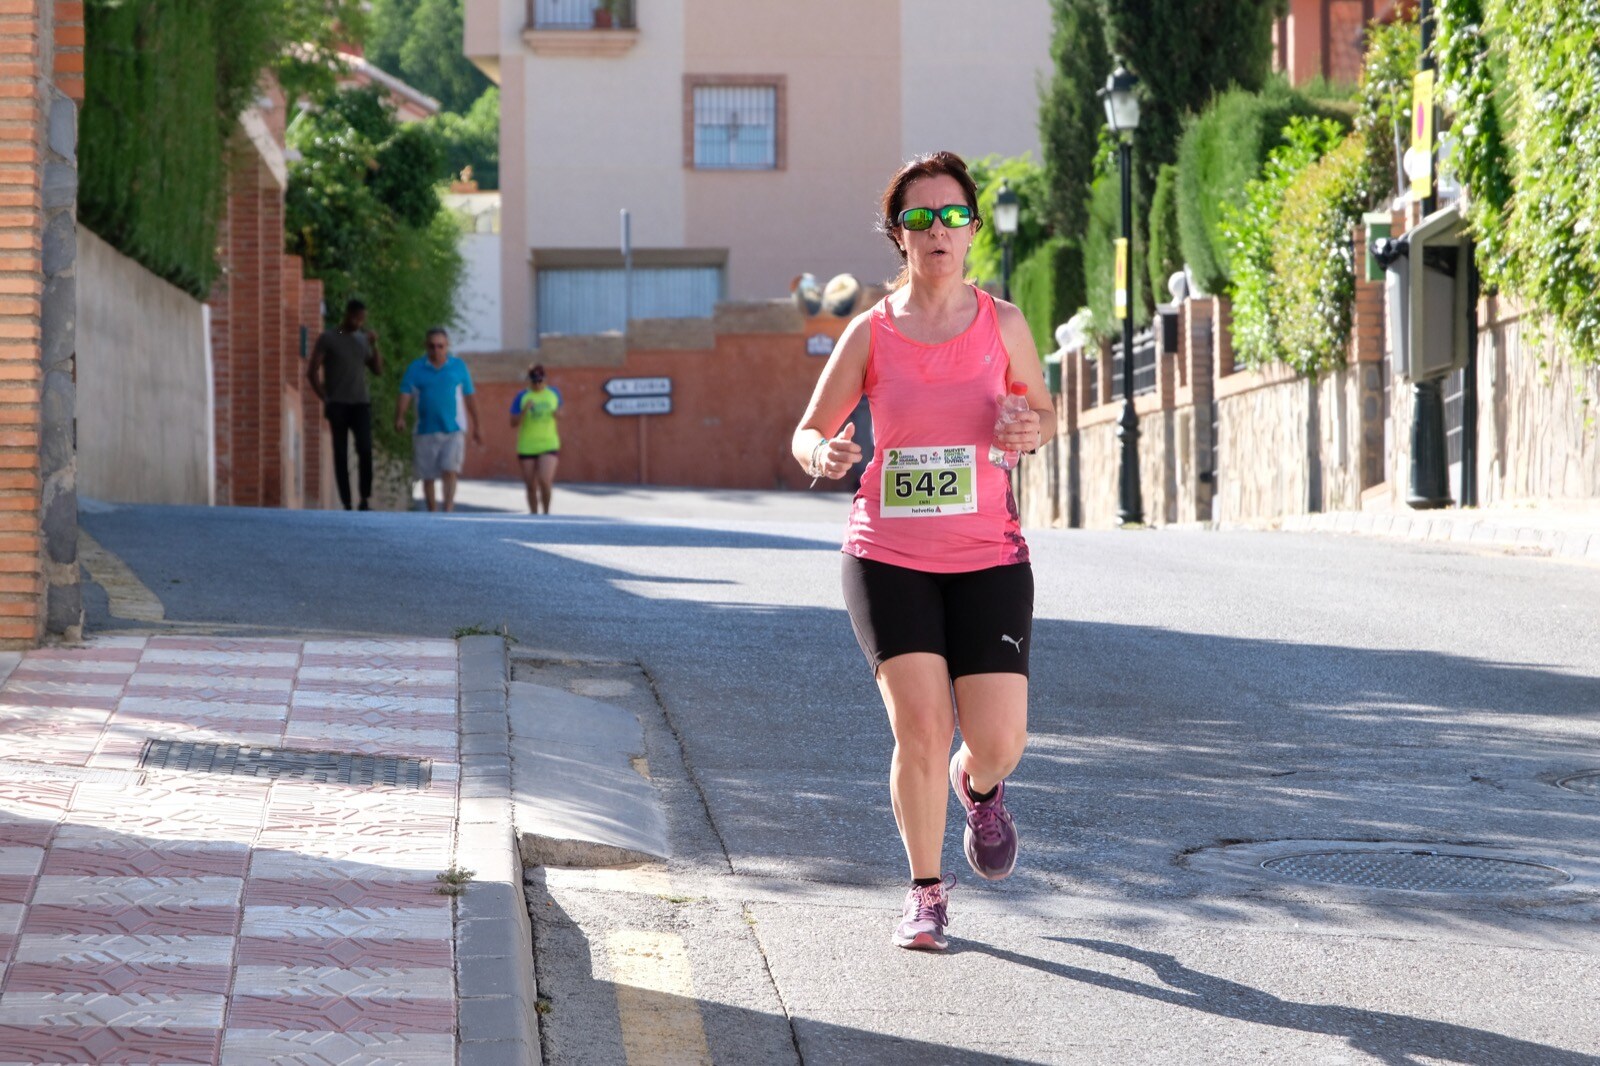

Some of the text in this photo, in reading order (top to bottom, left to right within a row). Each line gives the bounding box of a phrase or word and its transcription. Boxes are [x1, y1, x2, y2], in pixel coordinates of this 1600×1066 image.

[613, 381, 667, 391] LA ZUBIA
[895, 471, 958, 498] 542
